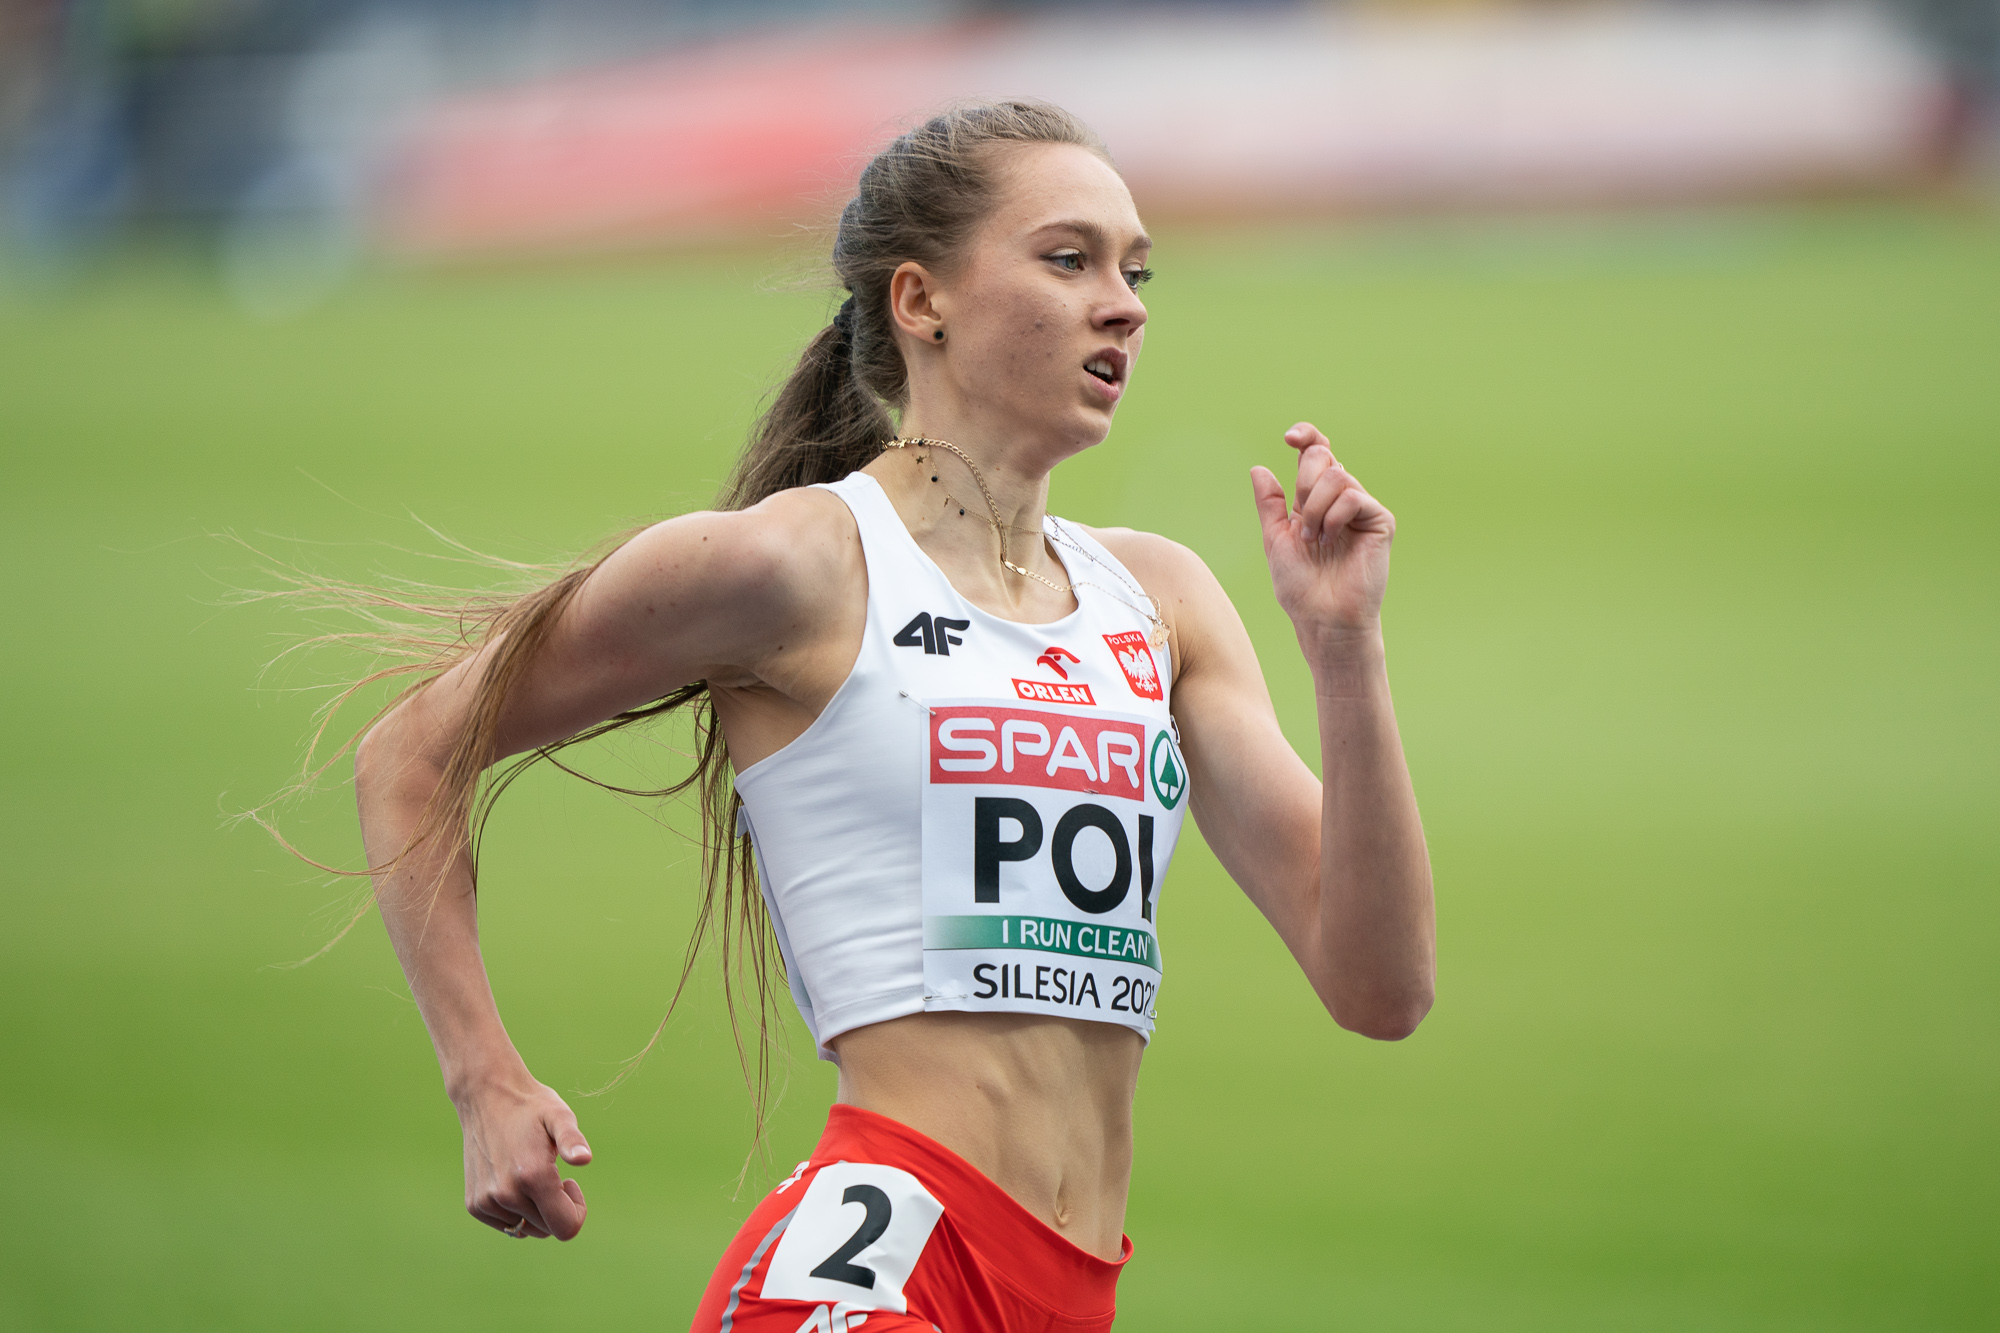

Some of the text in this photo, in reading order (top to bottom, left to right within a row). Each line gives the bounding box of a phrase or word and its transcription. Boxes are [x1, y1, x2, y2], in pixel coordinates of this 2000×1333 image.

[1107, 633, 1143, 645] POLSKA
[1018, 682, 1091, 704] ORLEN
[937, 717, 1141, 789] SPAR
[1002, 919, 1009, 944] I
[1020, 919, 1071, 950] RUN
[973, 963, 1155, 1016] SILESIA 202
[808, 1184, 892, 1291] 2
